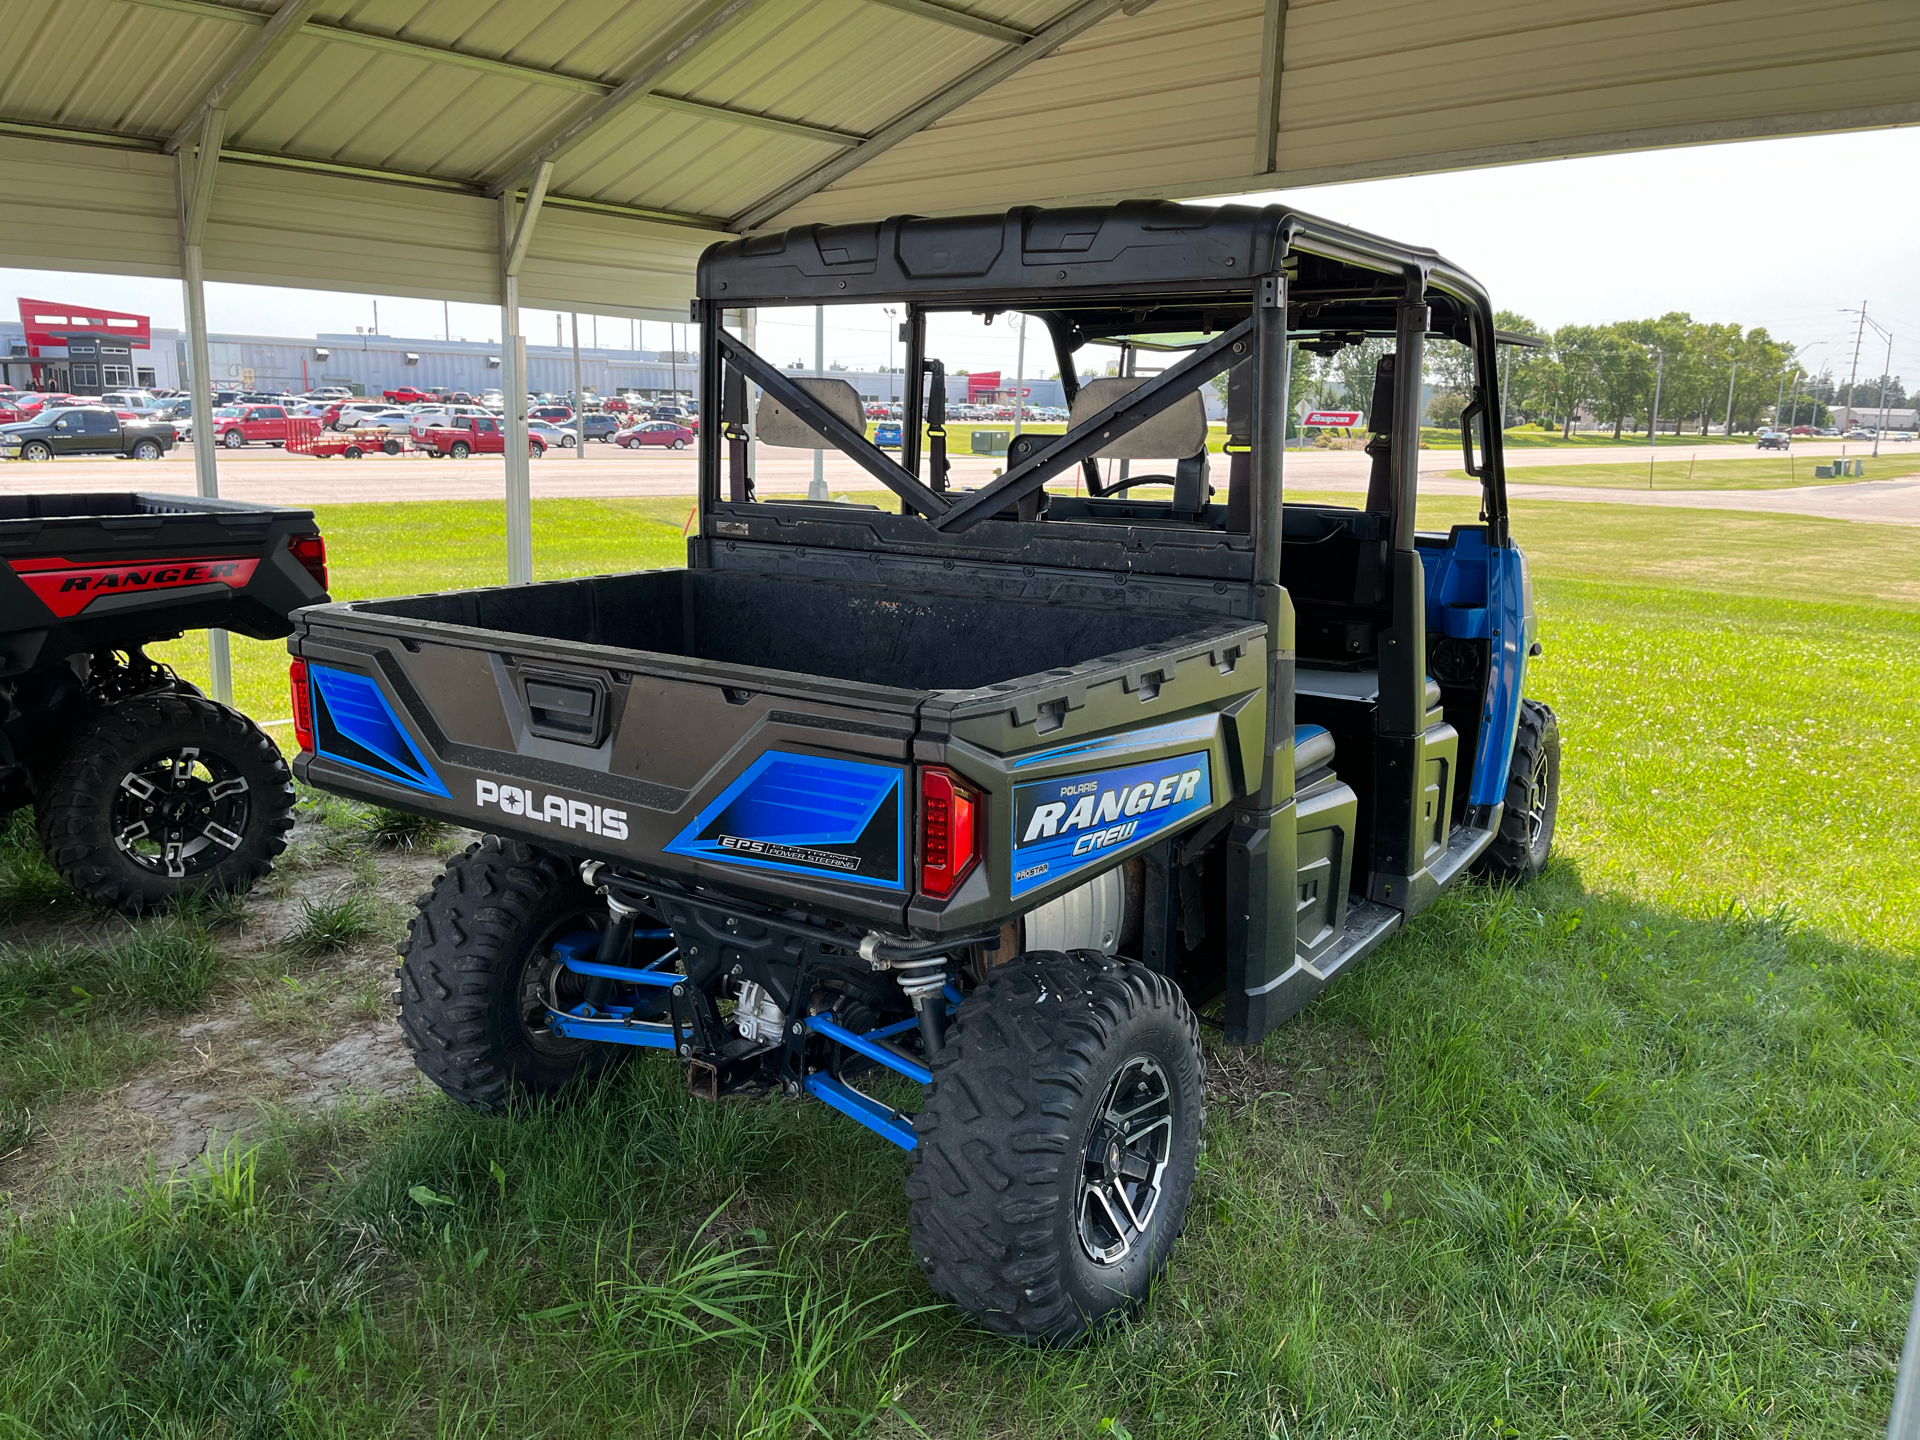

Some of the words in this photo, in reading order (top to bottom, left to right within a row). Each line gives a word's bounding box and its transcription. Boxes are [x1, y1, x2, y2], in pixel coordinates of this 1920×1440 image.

[59, 563, 238, 592] RANGER
[1060, 781, 1098, 797] POLARIS
[475, 778, 629, 841] POLARIS
[1022, 768, 1202, 844] RANGER
[722, 837, 764, 852] EPS
[1072, 819, 1139, 857] CREW
[769, 848, 806, 860] POWER
[807, 854, 855, 868] STEERING
[1016, 863, 1048, 881] PROSTAR
[1177, 1052, 1197, 1099] DIRT
